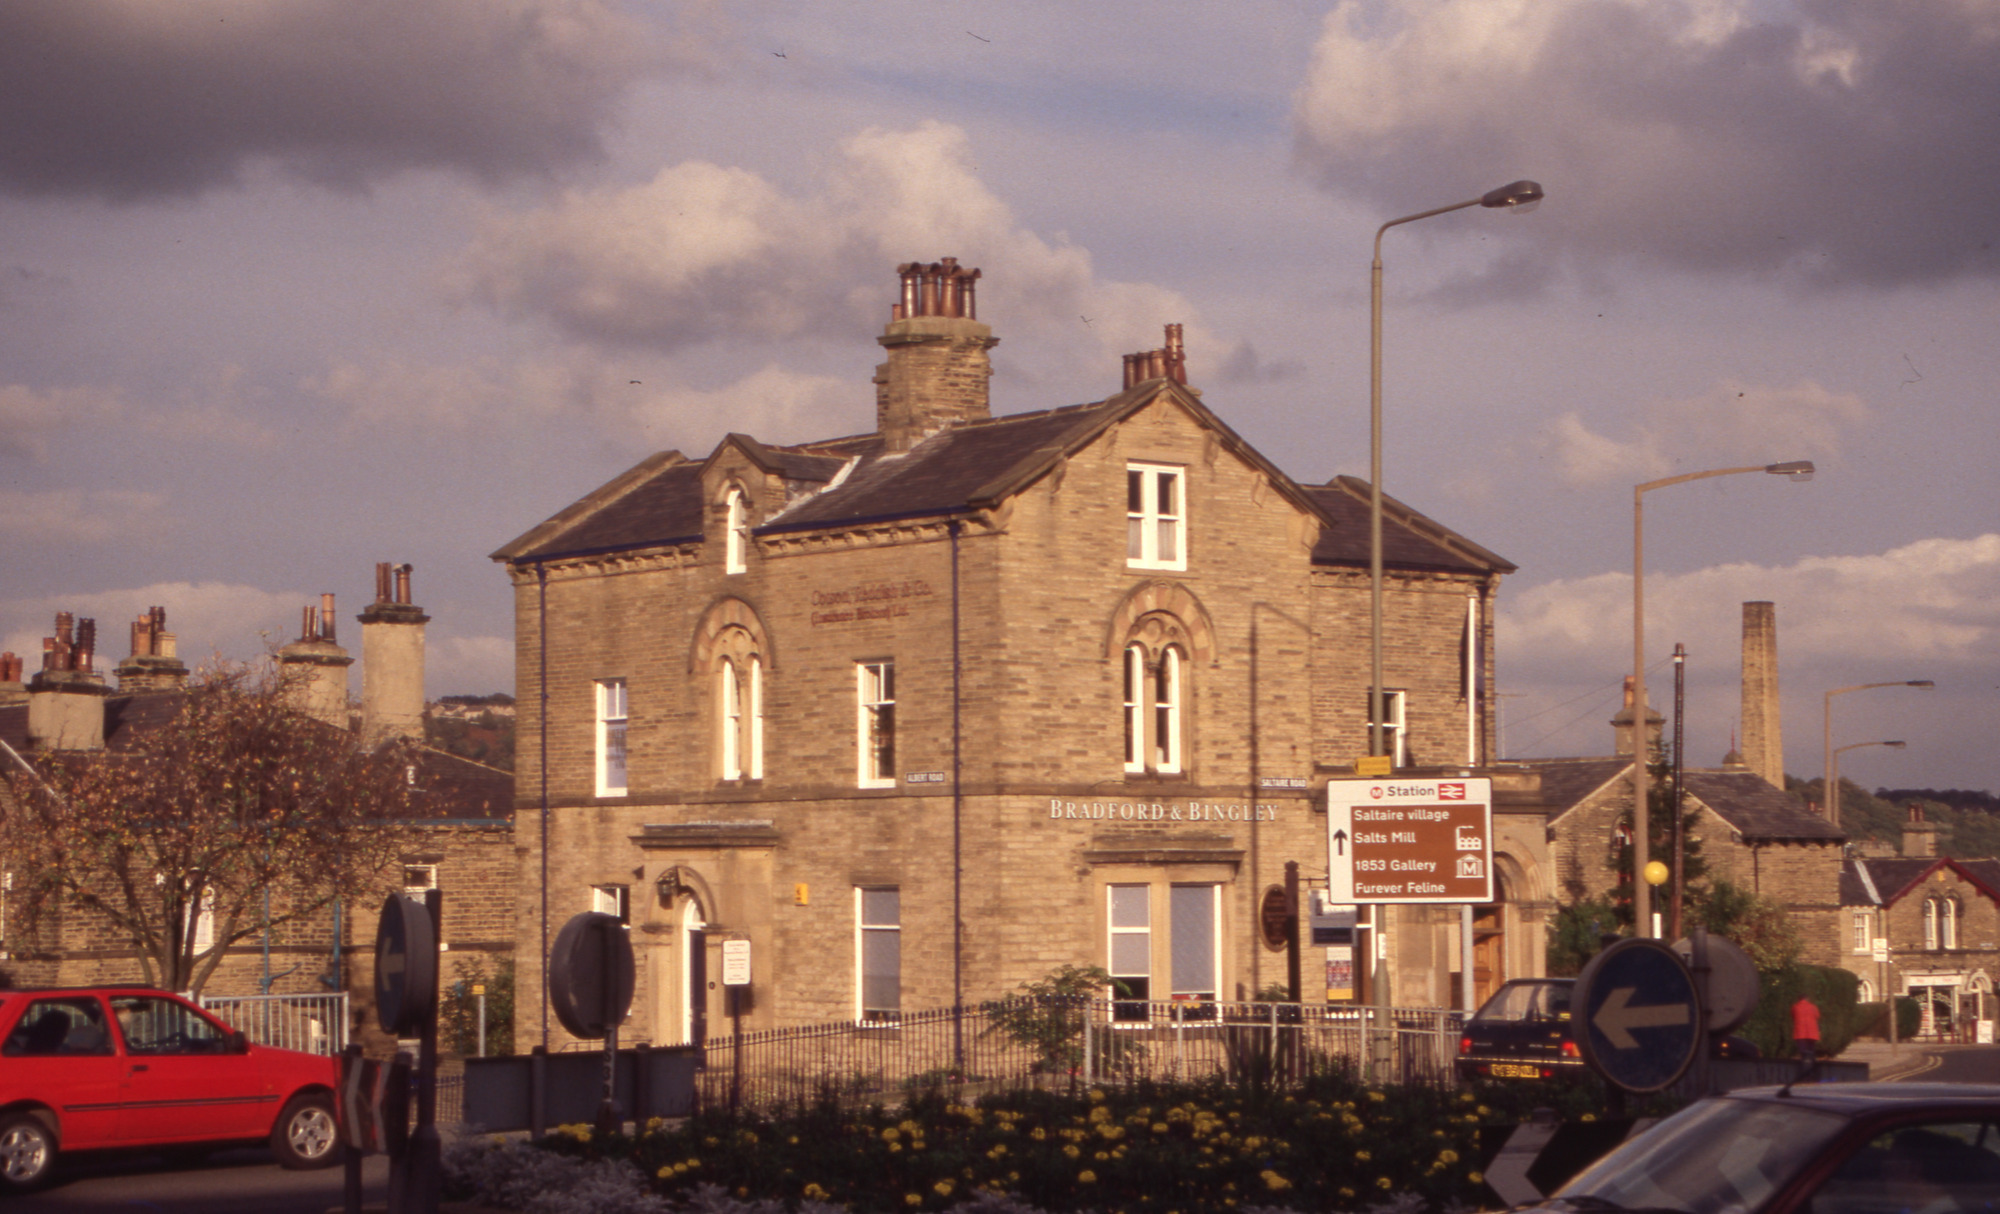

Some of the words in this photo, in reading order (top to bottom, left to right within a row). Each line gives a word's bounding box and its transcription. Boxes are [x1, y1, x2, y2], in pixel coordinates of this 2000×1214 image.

[928, 772, 944, 782] ROAD
[1290, 778, 1307, 788] ROAD
[1387, 786, 1435, 797] Station
[1170, 806, 1183, 821] &
[1353, 809, 1404, 822] Saltaire
[1407, 809, 1450, 823] village
[1354, 831, 1388, 844] Salts
[1391, 831, 1417, 844] Mill
[1355, 859, 1387, 872] 1853
[1390, 859, 1437, 873] Gallery
[1355, 882, 1403, 894] Furever
[1407, 881, 1446, 894] Feline
